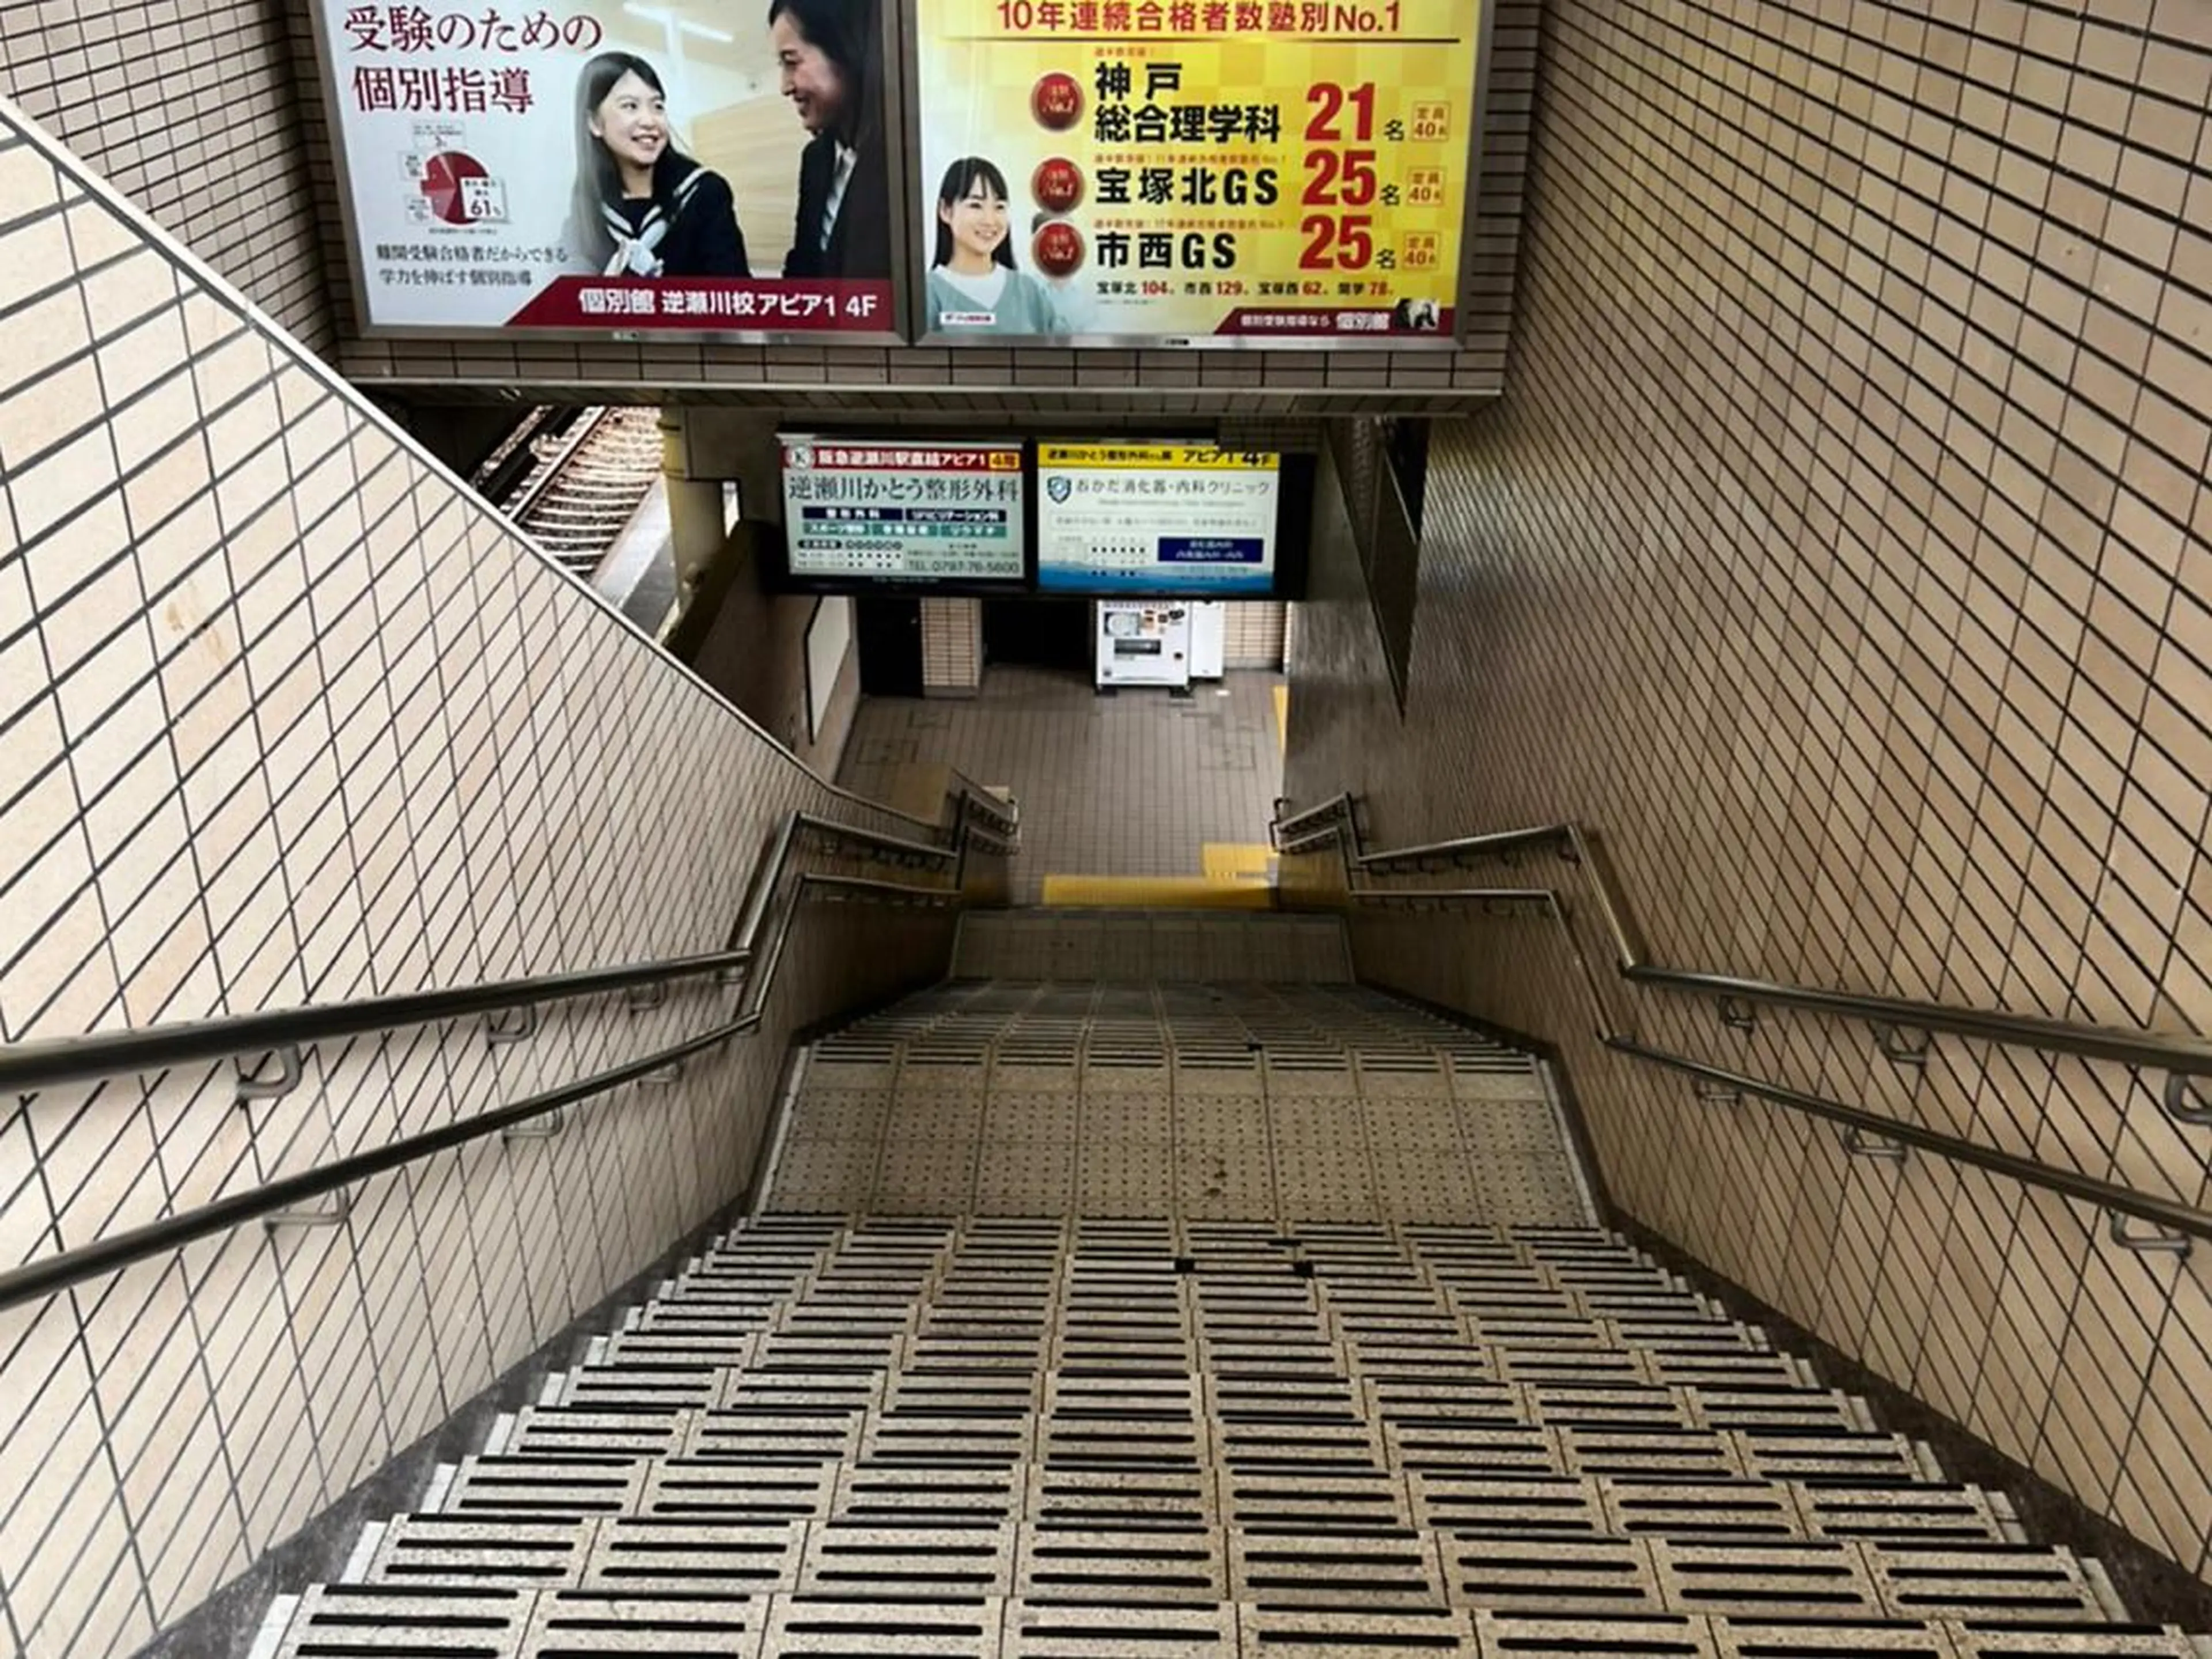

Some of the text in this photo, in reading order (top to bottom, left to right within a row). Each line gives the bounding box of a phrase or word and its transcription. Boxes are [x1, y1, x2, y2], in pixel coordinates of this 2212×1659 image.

[345, 6, 601, 52] 受験のための
[998, 1, 1399, 31] 10年連続合格者数塾別No.1
[353, 66, 534, 113] 個別指導
[1096, 62, 1182, 101] 神戸
[1095, 104, 1280, 142] 総合理学科
[1096, 166, 1278, 205] 宝塚北GS
[376, 244, 568, 263] 難関受験合格者だからできる
[1096, 232, 1236, 269] 市西GS
[380, 268, 532, 286] 学力を伸ばす個別指導
[579, 287, 656, 315] 個別館
[845, 294, 877, 317] 4F
[788, 476, 1019, 501] 逆瀬川かとう整形外科
